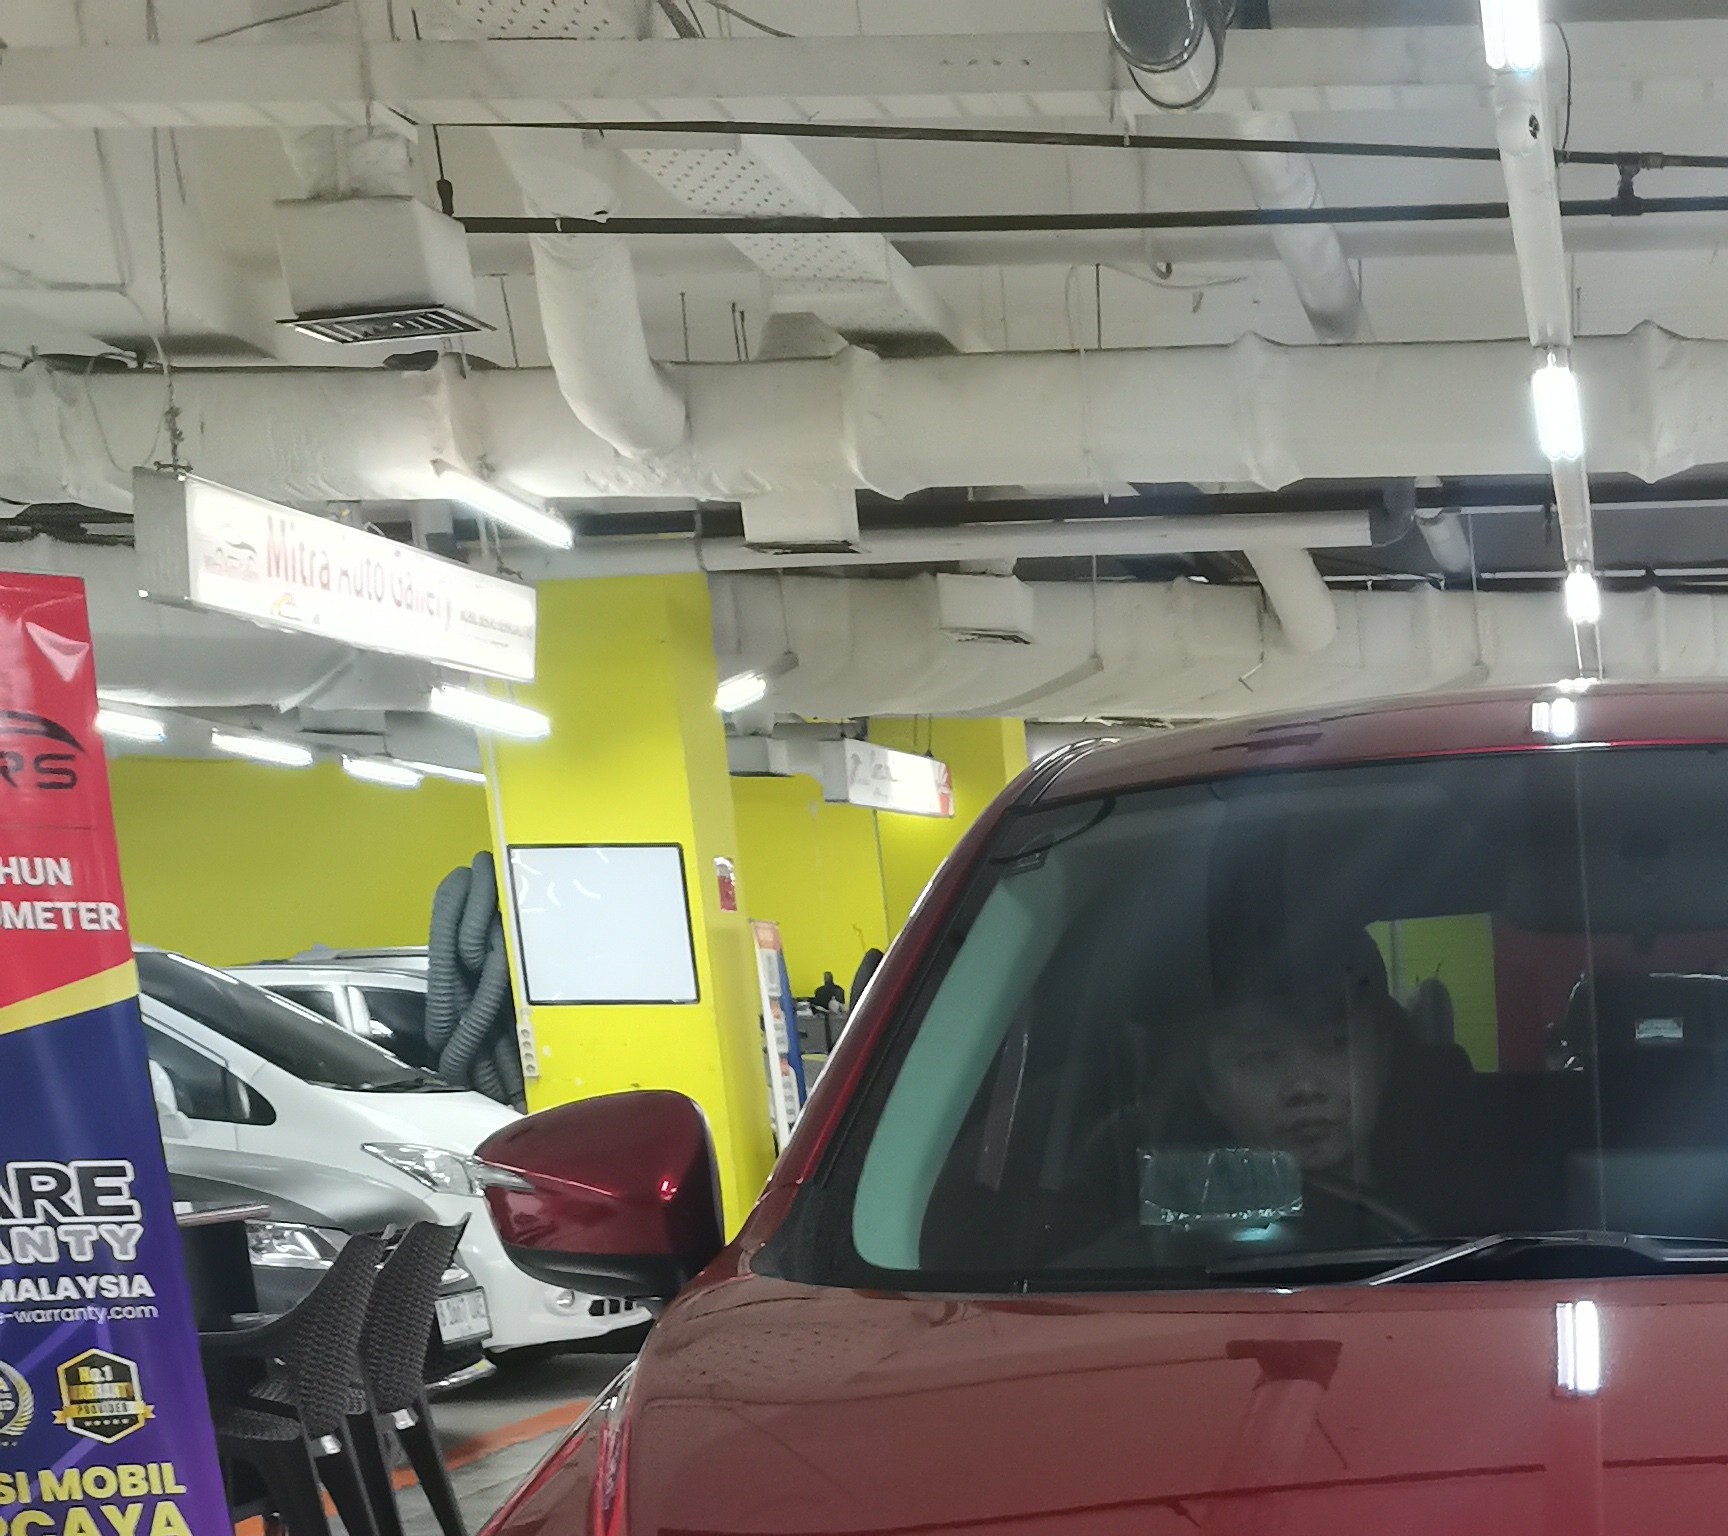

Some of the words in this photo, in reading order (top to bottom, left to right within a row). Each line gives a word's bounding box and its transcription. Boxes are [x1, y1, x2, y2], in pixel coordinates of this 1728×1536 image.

[267, 514, 331, 594] Mitra
[0, 900, 123, 931] METER
[37, 1461, 187, 1503] MOBIL
